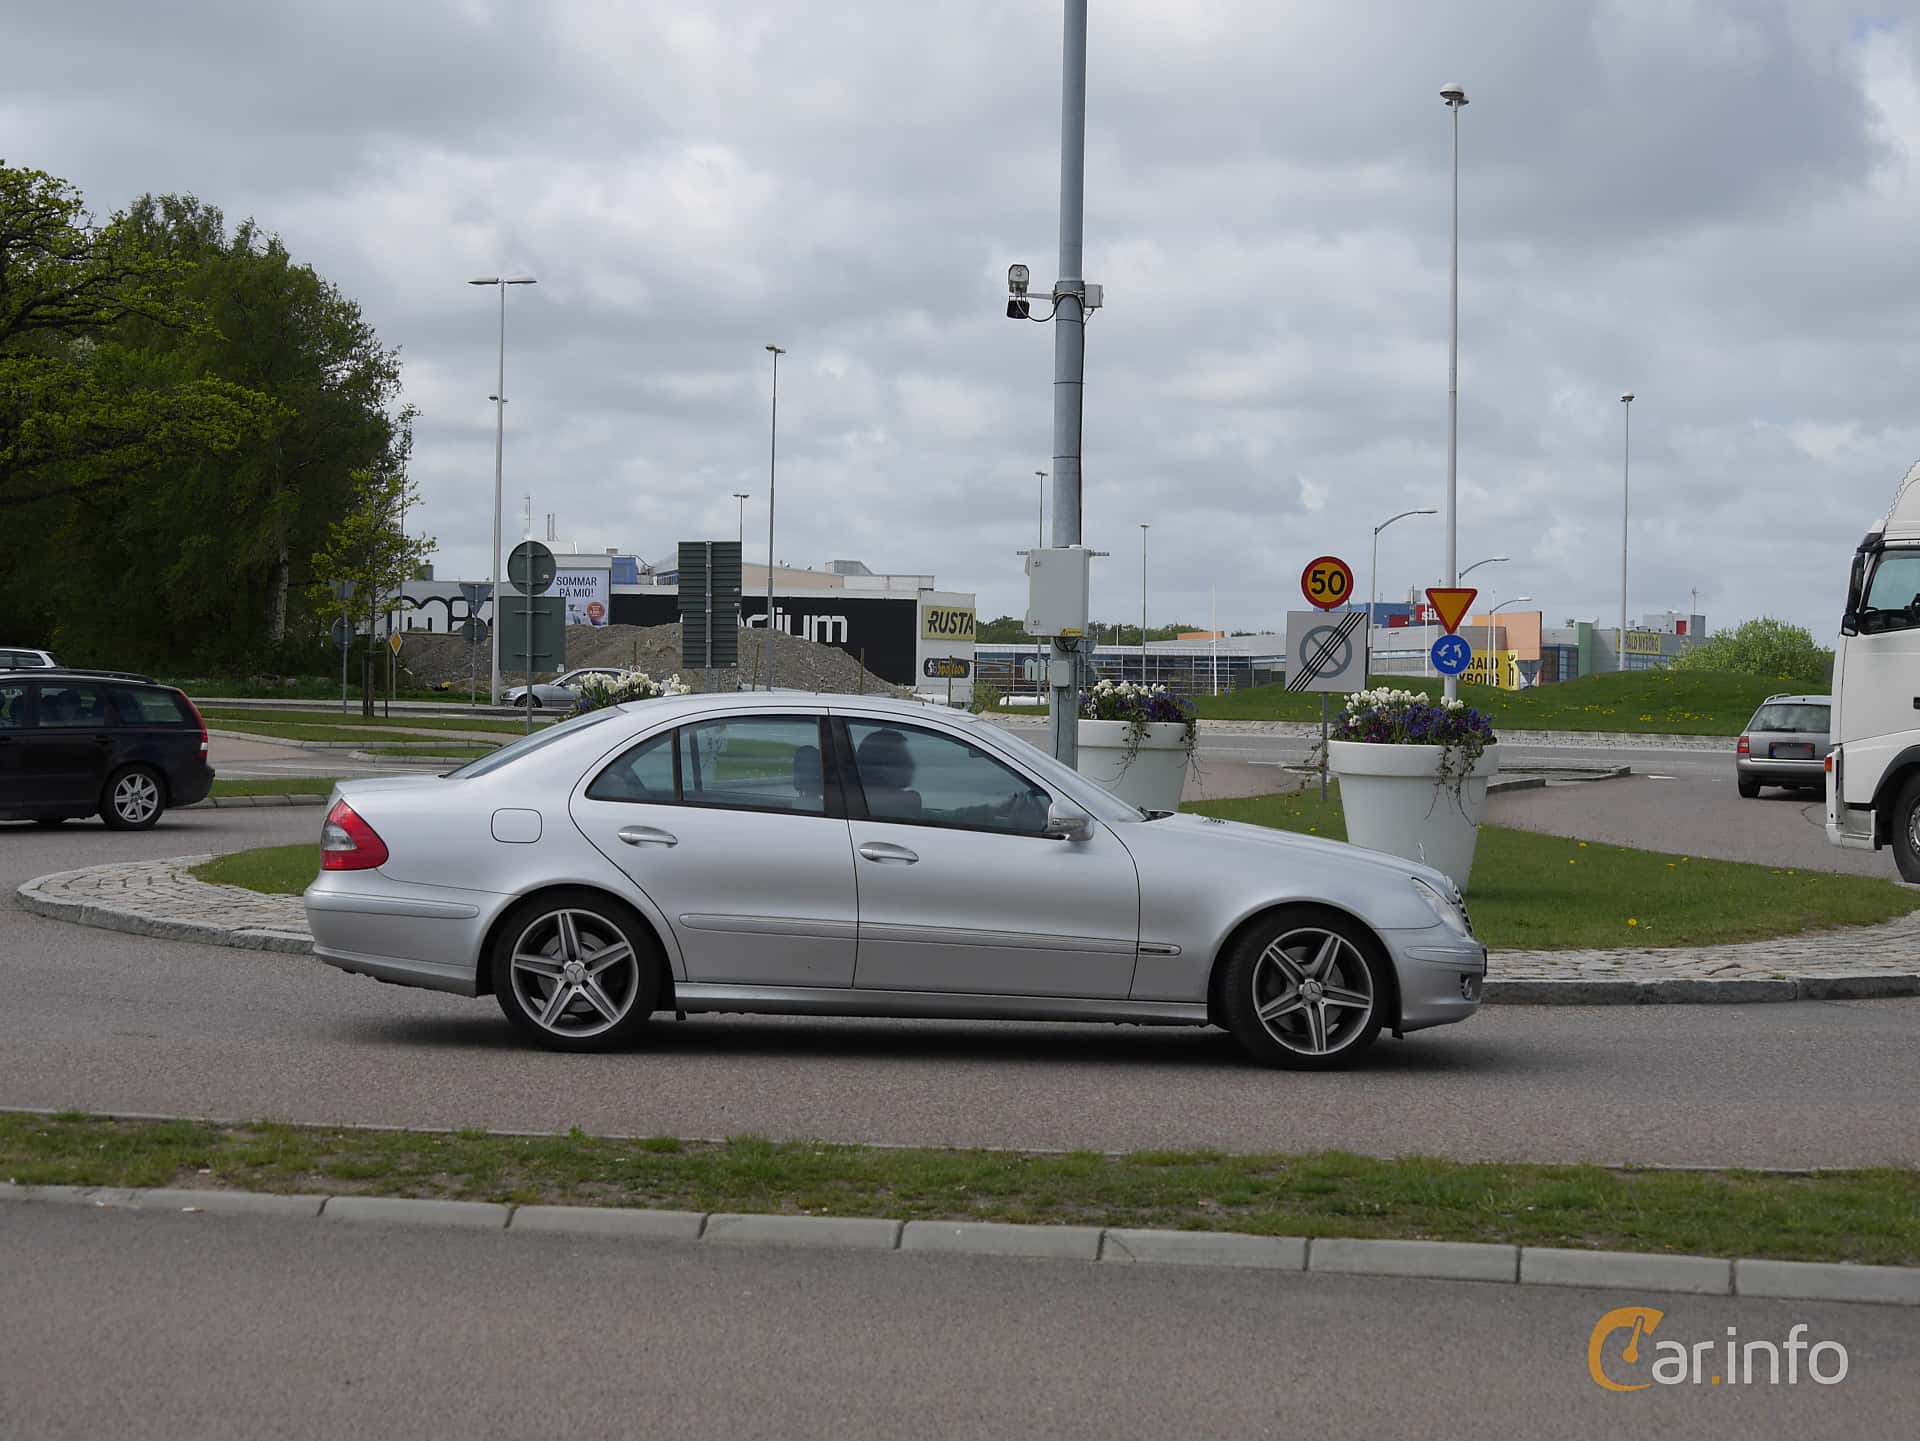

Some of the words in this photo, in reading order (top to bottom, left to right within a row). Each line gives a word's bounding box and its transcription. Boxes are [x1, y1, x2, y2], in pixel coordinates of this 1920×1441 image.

[556, 576, 597, 586] SOMMAR
[1311, 569, 1346, 595] 50
[559, 586, 571, 598] PÅ
[573, 587, 594, 598] MIO!
[927, 610, 974, 635] RUSTA
[1467, 656, 1500, 670] RALD
[1458, 672, 1501, 686] YBORG
